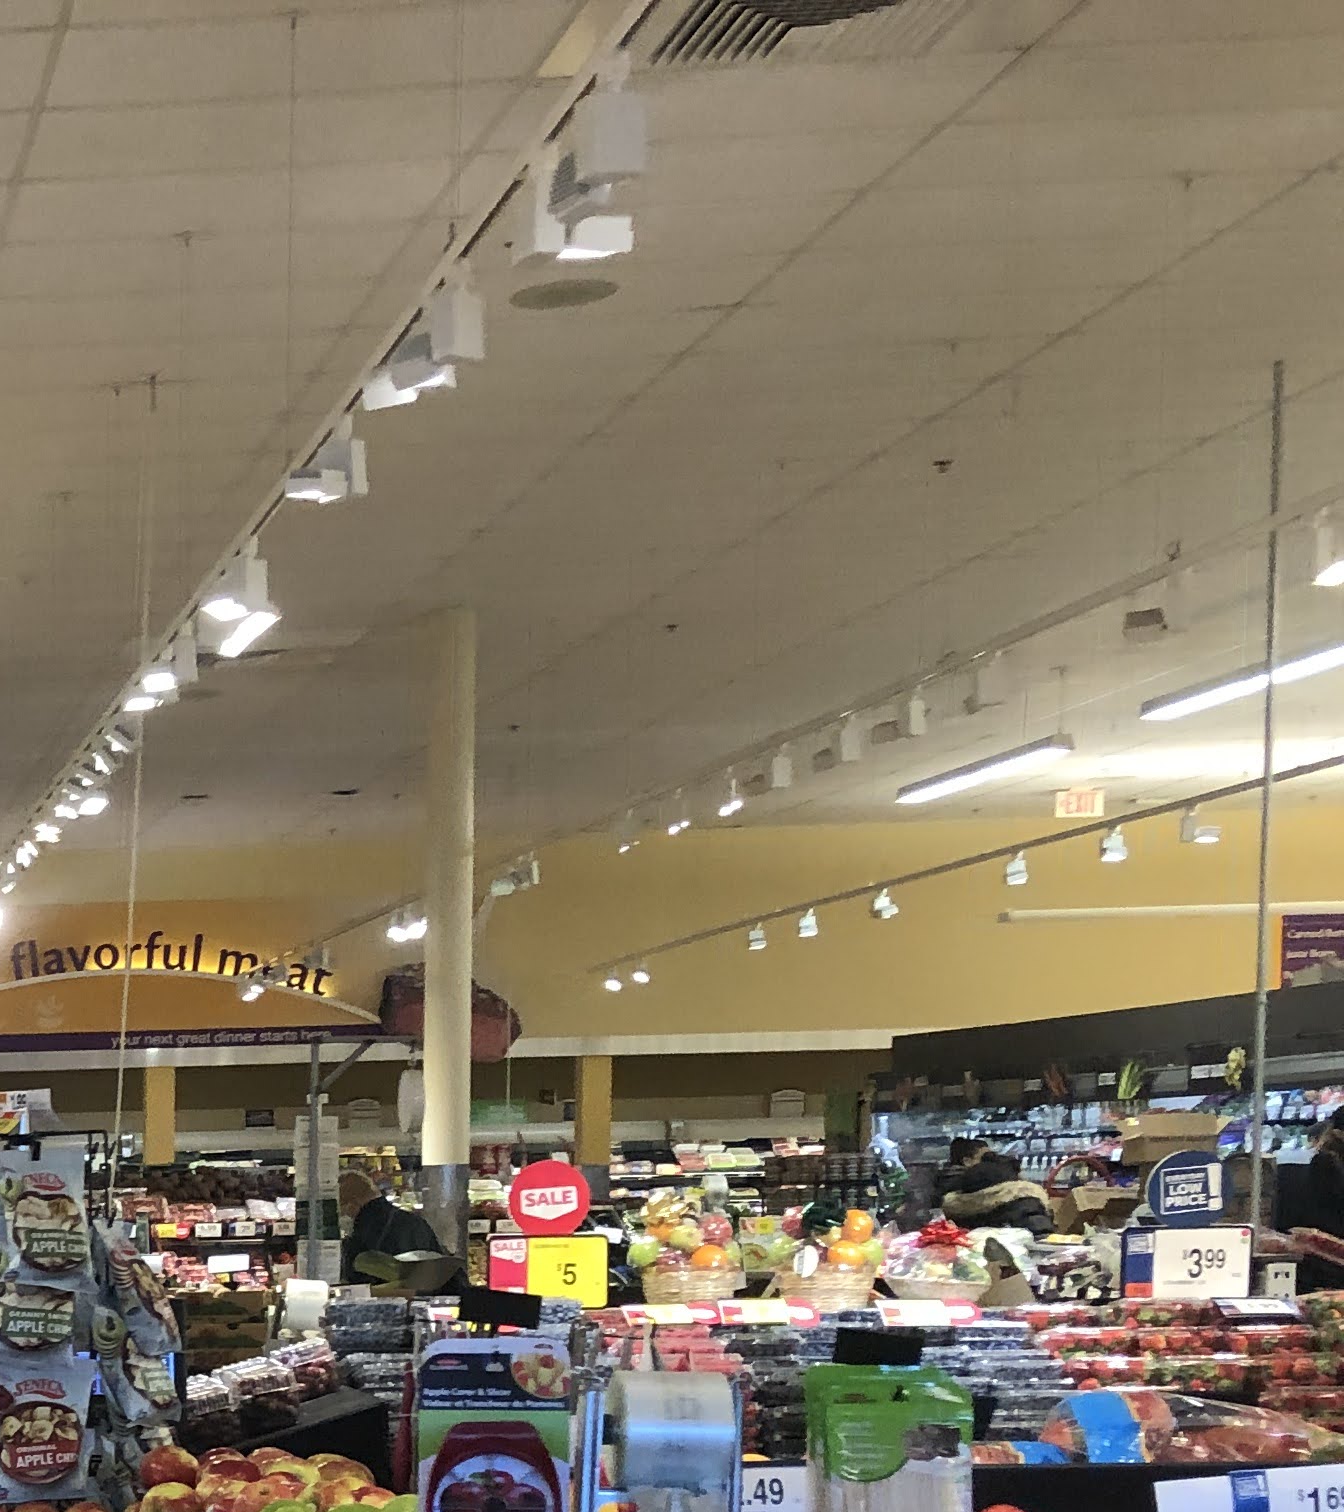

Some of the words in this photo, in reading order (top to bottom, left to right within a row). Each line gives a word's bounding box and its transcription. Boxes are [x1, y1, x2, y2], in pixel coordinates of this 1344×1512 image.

[11, 931, 203, 980] flavorful
[144, 1032, 173, 1044] next
[176, 1031, 210, 1047] great
[214, 1029, 255, 1043] dinner
[260, 1028, 297, 1042] starts
[1169, 1183, 1203, 1196] LOW
[525, 1190, 574, 1208] SALE
[1165, 1193, 1208, 1208] PRICE
[32, 1241, 65, 1253] APPLE
[493, 1242, 525, 1252] SALE
[6, 1319, 45, 1333] APPLE
[16, 1454, 53, 1469] APPLE
[739, 1477, 784, 1505] .49
